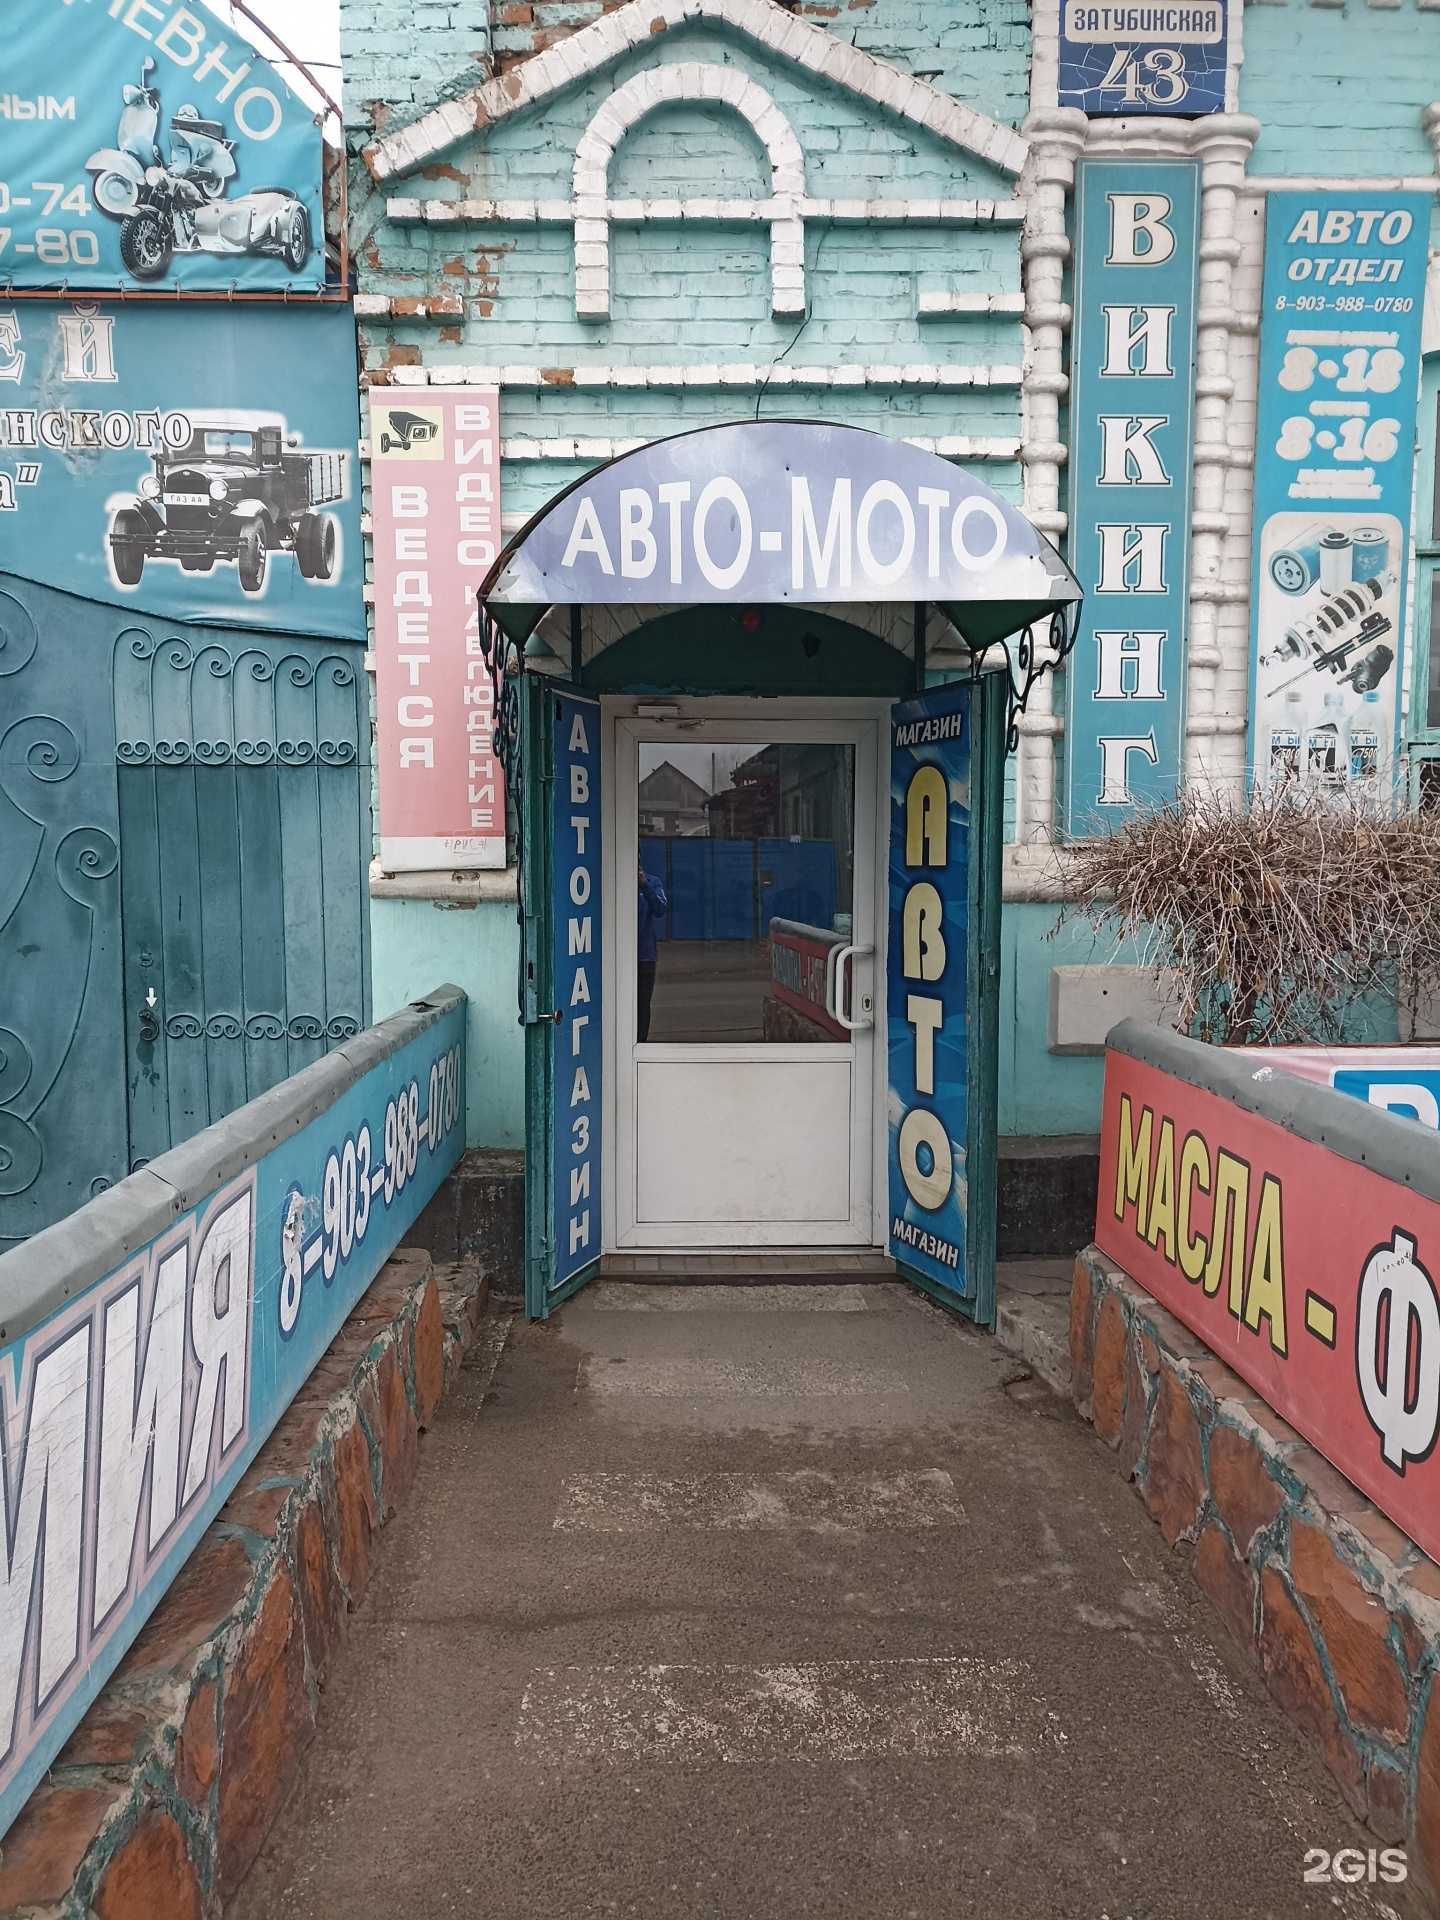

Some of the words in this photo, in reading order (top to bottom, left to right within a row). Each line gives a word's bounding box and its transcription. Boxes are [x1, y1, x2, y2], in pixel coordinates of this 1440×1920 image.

[1074, 8, 1216, 33] ЗАТУБИНСКАЯ
[107, 0, 282, 141] ЕВНО
[1100, 49, 1189, 106] 43
[1287, 210, 1413, 245] АВТО
[1275, 295, 1414, 313] 8-903-988-0780
[1287, 257, 1404, 286] ОТДЕЛ
[561, 476, 1008, 590] АВТО-МОТО
[1094, 193, 1176, 804] ВИКИНГ
[391, 485, 434, 769] ВЕДЕТСЯ
[895, 713, 962, 748] МАГАЗИН
[568, 713, 593, 1256] АВТОМАГАЗИН
[899, 765, 953, 1210] АВТО
[893, 1217, 959, 1268] МАГАЗИН
[1114, 1093, 1288, 1360] МАСЛА
